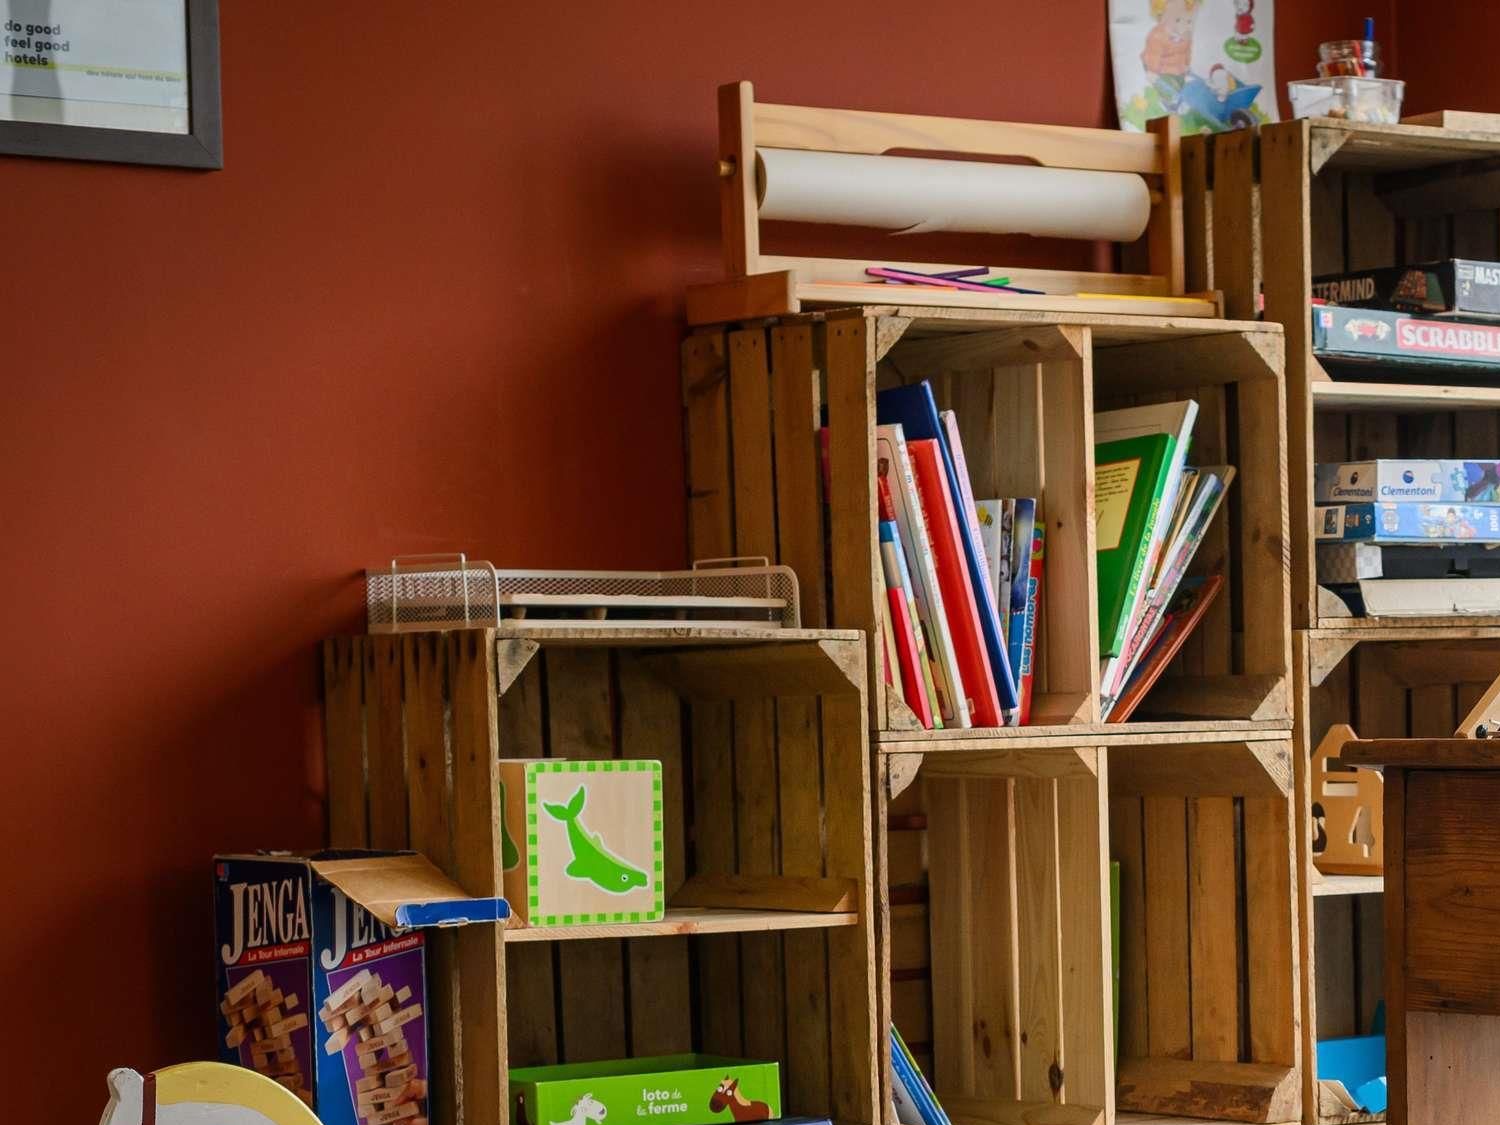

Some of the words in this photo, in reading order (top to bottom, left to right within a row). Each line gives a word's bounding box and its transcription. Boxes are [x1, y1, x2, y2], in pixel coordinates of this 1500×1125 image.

[4, 20, 22, 32] do
[26, 24, 61, 36] good
[5, 36, 31, 48] feel
[35, 41, 70, 52] good
[5, 52, 48, 65] hotels
[1381, 485, 1436, 497] Clementoni
[221, 876, 311, 966] JENGA
[353, 952, 363, 962] La
[364, 946, 382, 959] Tour
[643, 1088, 670, 1101] loto
[648, 1102, 688, 1116] ferme
